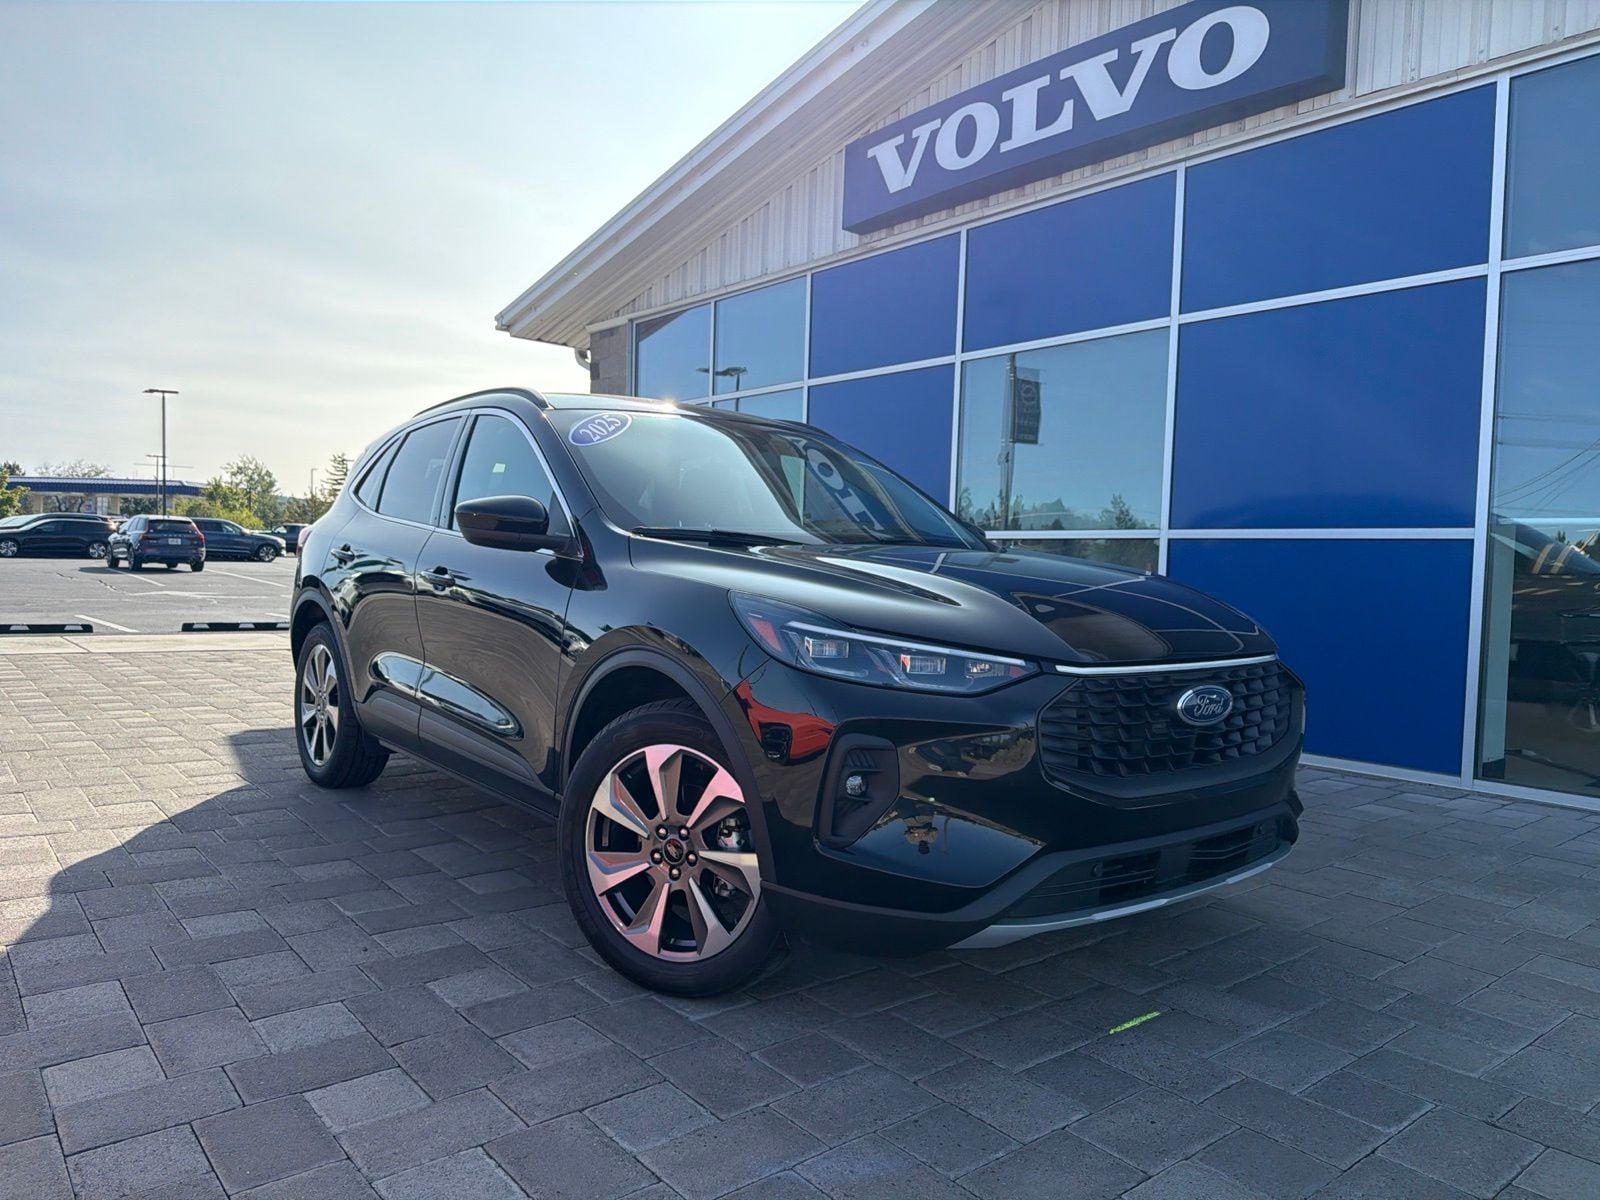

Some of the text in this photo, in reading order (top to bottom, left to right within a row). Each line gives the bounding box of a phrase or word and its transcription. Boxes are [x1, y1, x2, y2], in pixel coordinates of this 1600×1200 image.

[867, 5, 1270, 194] VOLVO
[579, 414, 622, 442] 2025
[1194, 694, 1225, 717] Ford
